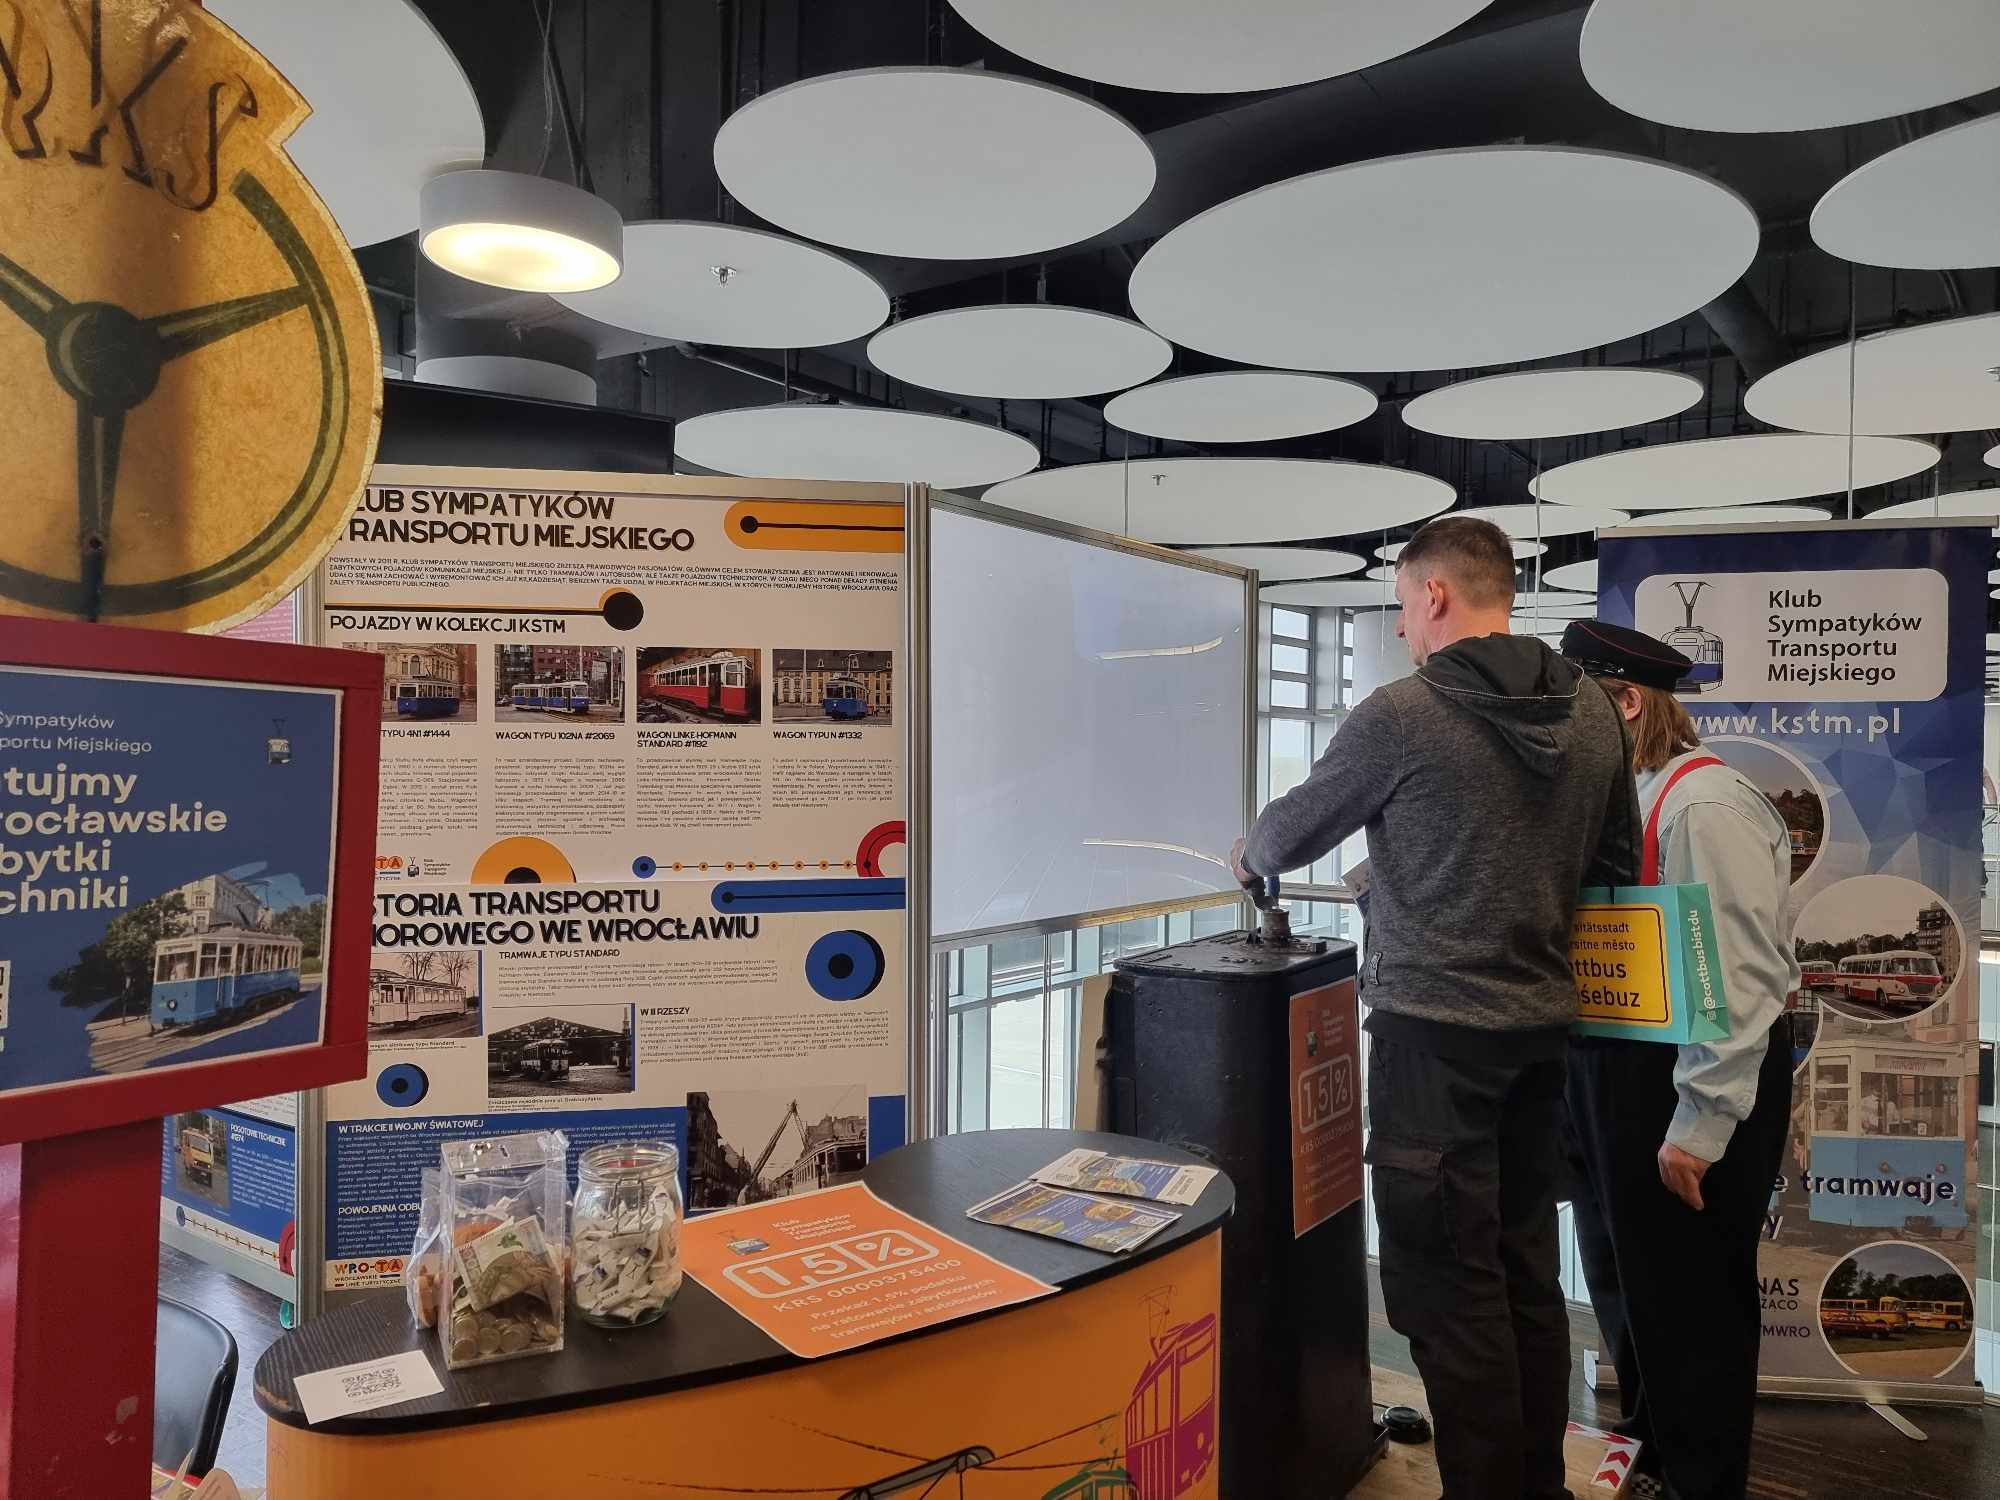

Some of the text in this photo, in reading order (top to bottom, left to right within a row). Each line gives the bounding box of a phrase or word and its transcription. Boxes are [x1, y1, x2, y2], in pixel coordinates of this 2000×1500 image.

[411, 490, 614, 520] SYMPATYKÓW
[338, 519, 694, 552] RANSPORTU MIEJSKIEGO
[329, 557, 367, 565] POWSTAŁY
[420, 559, 468, 567] SYMPATYKÓW
[471, 560, 514, 568] TRANSPORTU
[516, 561, 557, 569] MIEJSKIEGO
[586, 563, 635, 571] PRAWDZIWYCH
[745, 568, 801, 576] STOWARZYSZENIA
[384, 565, 422, 573] POJAZDÓW
[425, 567, 471, 575] KOMUNIKACJI
[473, 568, 506, 576] MIEJSKIEJ
[551, 569, 594, 578] TRAMWAJÓW
[681, 573, 718, 581] POJAZDÓW
[779, 576, 798, 584] CIĄGU
[870, 578, 898, 586] ISTNIENIA
[355, 572, 366, 580] SIĘ
[384, 572, 425, 581] ZACHOWAĆ
[430, 573, 489, 582] WYREMONTOWAĆ
[602, 577, 621, 585] TAKŻE
[743, 581, 771, 589] KTÓRYCH
[813, 583, 840, 592] HISTORIĘ
[881, 584, 898, 592] ORAZ
[355, 579, 400, 587] TRANSPORTU
[1769, 589, 1822, 609] Klub
[330, 615, 566, 634] POJAZDY W KOLEKCJI KSTM
[1768, 612, 1921, 637] Sympatyków
[1767, 639, 1897, 661] Transportu
[1768, 662, 1896, 687] Miejskiego
[381, 730, 405, 738] TYPU
[422, 730, 451, 738] #1444
[1688, 707, 1900, 743] www.kstm.pl
[496, 731, 615, 741] WAGON TYPU 102NA #2069
[637, 731, 672, 740] WAGON
[637, 740, 682, 749] STANDARD
[773, 731, 808, 740] WAGON
[809, 732, 829, 740] TYPU
[838, 732, 863, 740] #1332
[57, 737, 152, 756] Miejskiego
[0, 801, 228, 835] ocławskie
[371, 889, 660, 917] TORIA TRANSPORTU
[540, 919, 581, 944] WE
[588, 915, 760, 944] WROCŁAWIU
[499, 948, 621, 960] TRAMWAJE TYPU STANDARD
[1571, 939, 1599, 951] sitne
[1688, 909, 1715, 1009] @cottbusbistdu
[1577, 983, 1641, 1008] śebuz
[640, 1008, 650, 1016] W
[657, 1007, 690, 1016] RZESZY
[338, 1125, 347, 1134] W
[349, 1123, 388, 1133] TRAKCIE
[394, 1122, 427, 1131] WOJNY
[430, 1119, 484, 1130] ŚWIATOWEJ
[1801, 1171, 1955, 1206] tramwaje
[338, 1204, 397, 1216] POWOJENNA
[334, 1274, 378, 1283] WROCŁAWSKIE
[773, 1259, 962, 1312] KRS 0000375400
[811, 1279, 996, 1334] na ratowanie zabytkowych
[830, 1312, 914, 1339] tramwajów
[1760, 1324, 1811, 1338] MWRO
